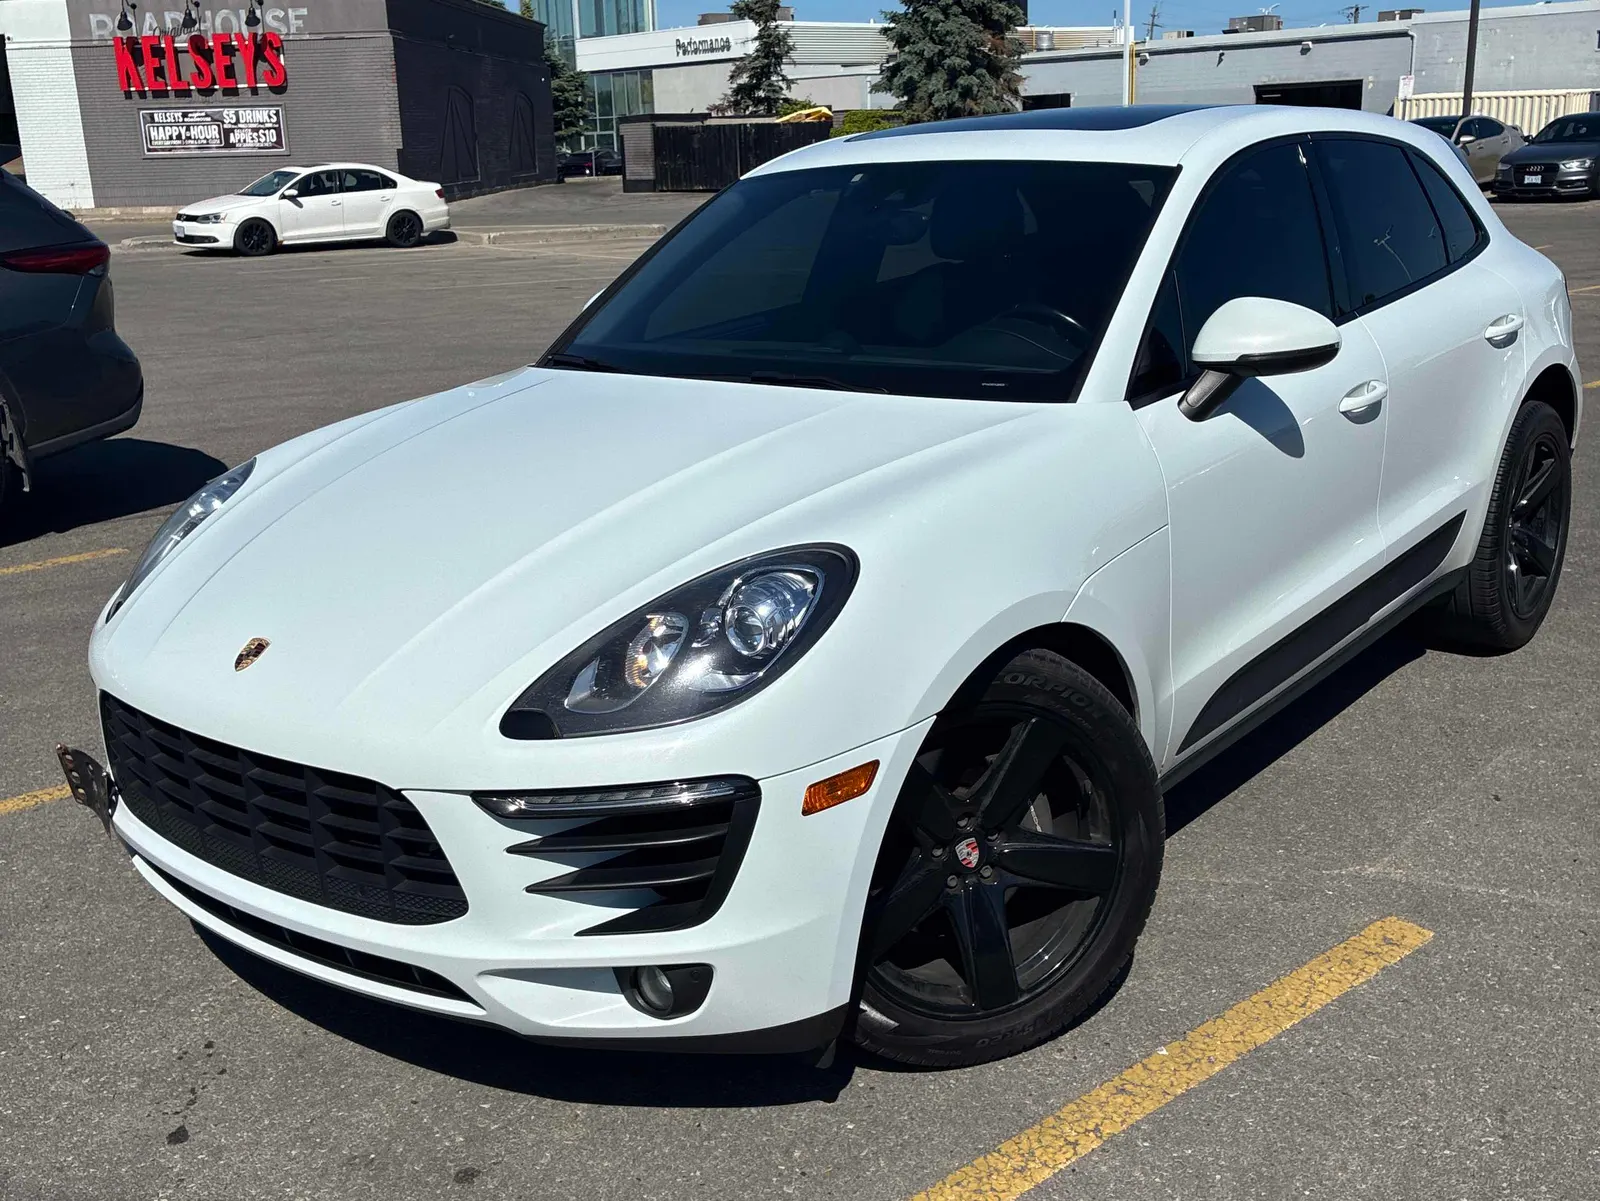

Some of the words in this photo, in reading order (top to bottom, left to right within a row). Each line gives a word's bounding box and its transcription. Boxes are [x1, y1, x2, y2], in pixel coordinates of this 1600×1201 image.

[676, 37, 731, 53] Performance
[113, 31, 285, 91] KELSEYS
[154, 112, 183, 122] KELSEYS
[223, 109, 236, 124] $5
[239, 110, 277, 123] DRINKS
[149, 126, 186, 140] HAPPY
[190, 125, 220, 139] HOUR
[230, 132, 258, 143] APPIES
[259, 129, 277, 143] $10
